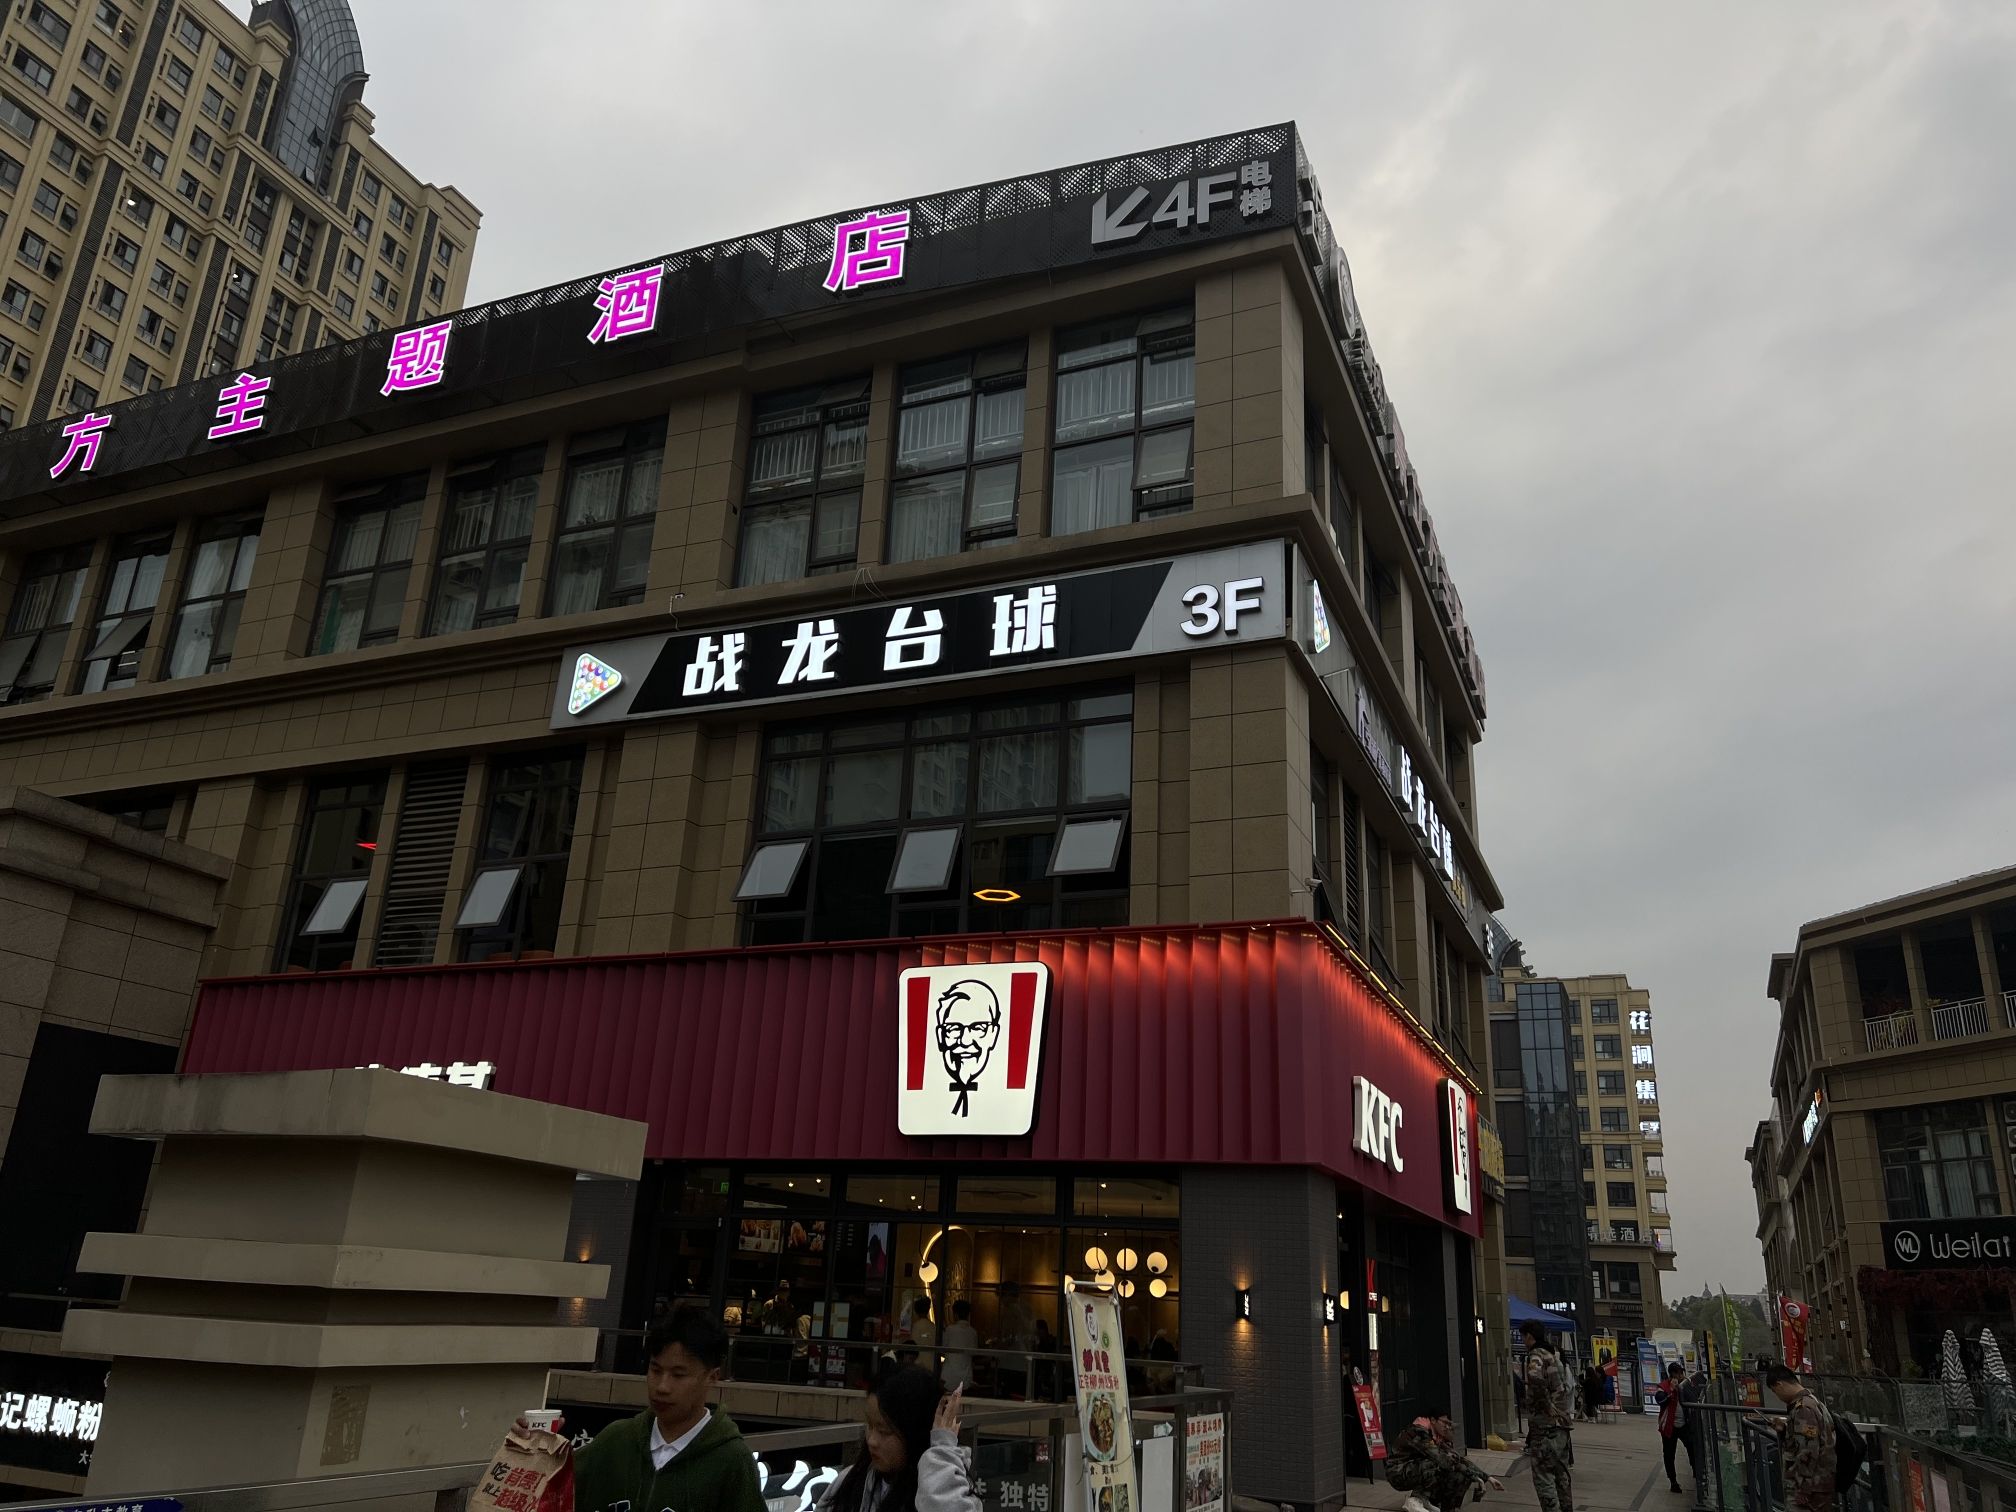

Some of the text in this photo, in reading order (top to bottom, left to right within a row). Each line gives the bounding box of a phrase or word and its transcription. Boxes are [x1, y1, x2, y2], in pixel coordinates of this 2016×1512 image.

[1153, 172, 1236, 229] 4F
[1239, 160, 1272, 216] 电梯
[49, 207, 912, 480] 方主题酒店
[680, 576, 1265, 697] 战龙台球 3F
[1353, 1076, 1404, 1173] KFC
[1325, 1296, 1335, 1321] KFC
[0, 1392, 104, 1441] 记螺蛳粉
[531, 1421, 548, 1429] KFC
